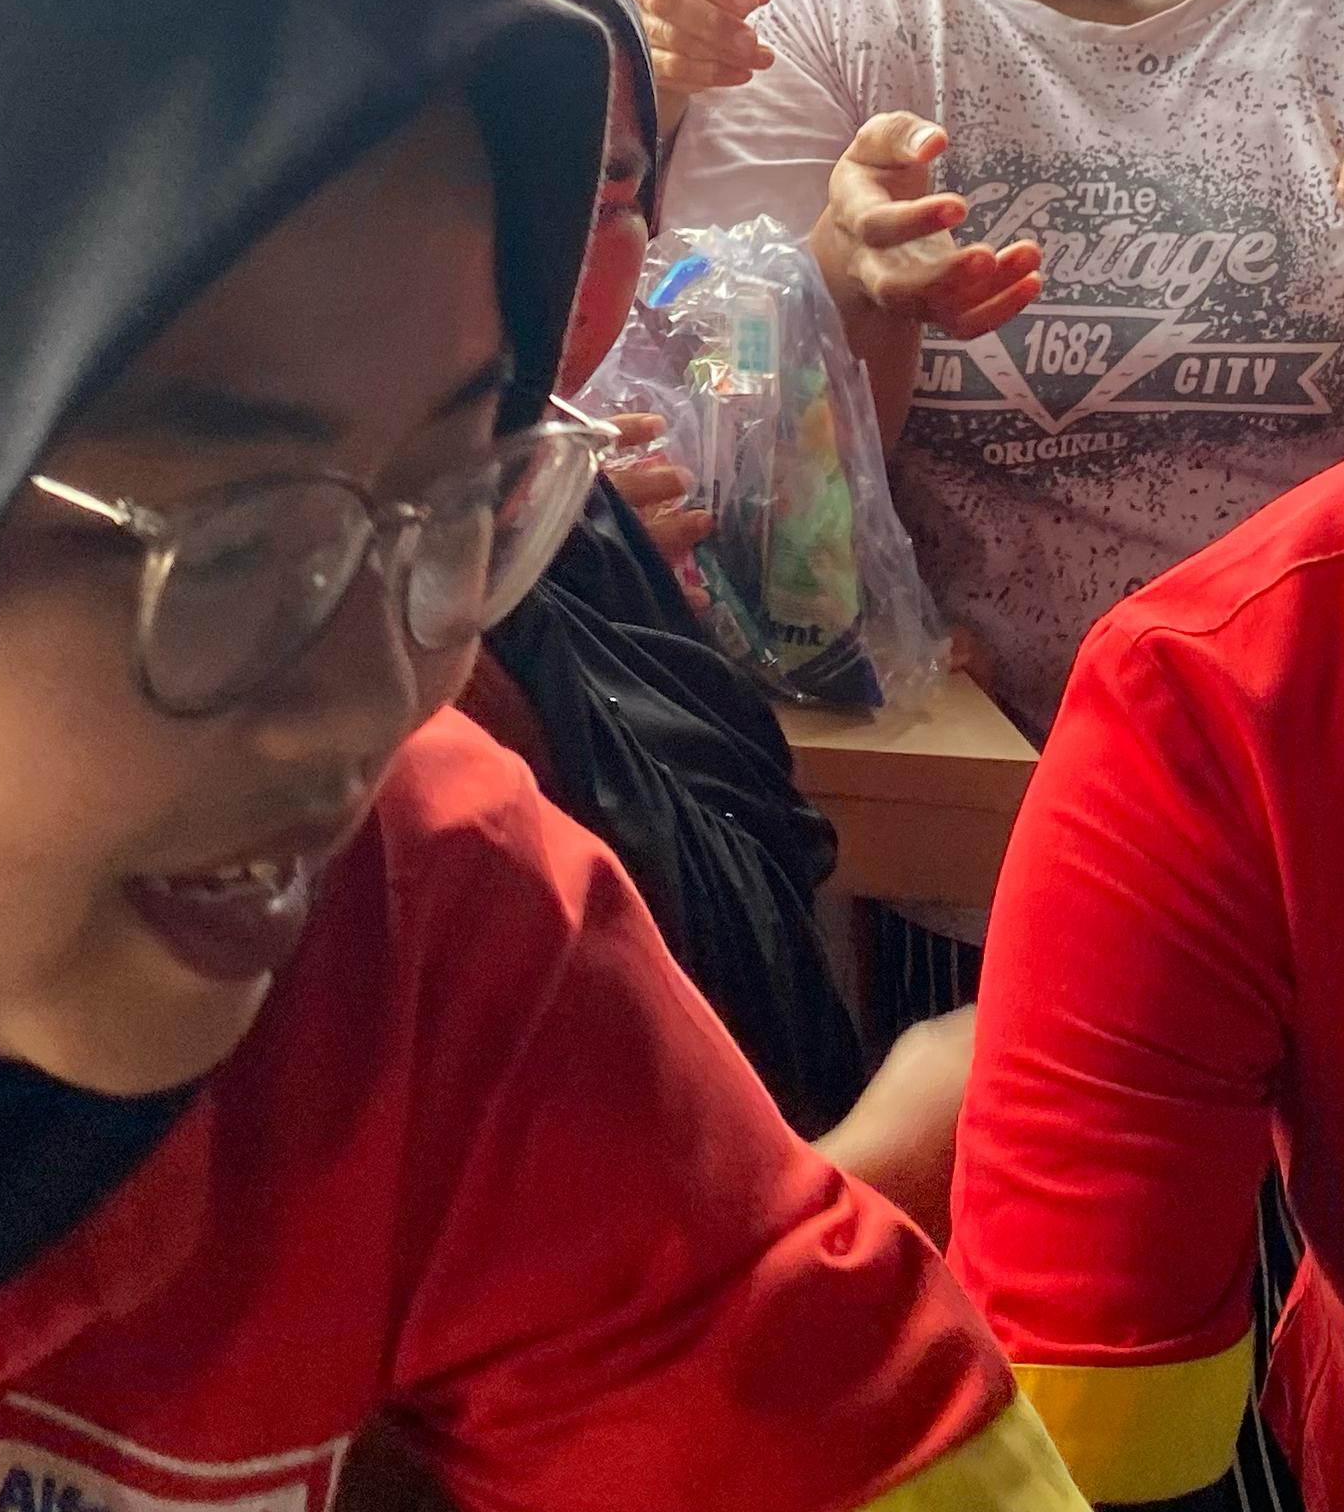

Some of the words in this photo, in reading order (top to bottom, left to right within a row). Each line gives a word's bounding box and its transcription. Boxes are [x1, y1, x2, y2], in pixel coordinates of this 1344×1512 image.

[1076, 181, 1157, 215] The
[1024, 320, 1112, 376] 1682
[1173, 357, 1276, 396] CITY
[983, 431, 1128, 466] ORIGINAL
